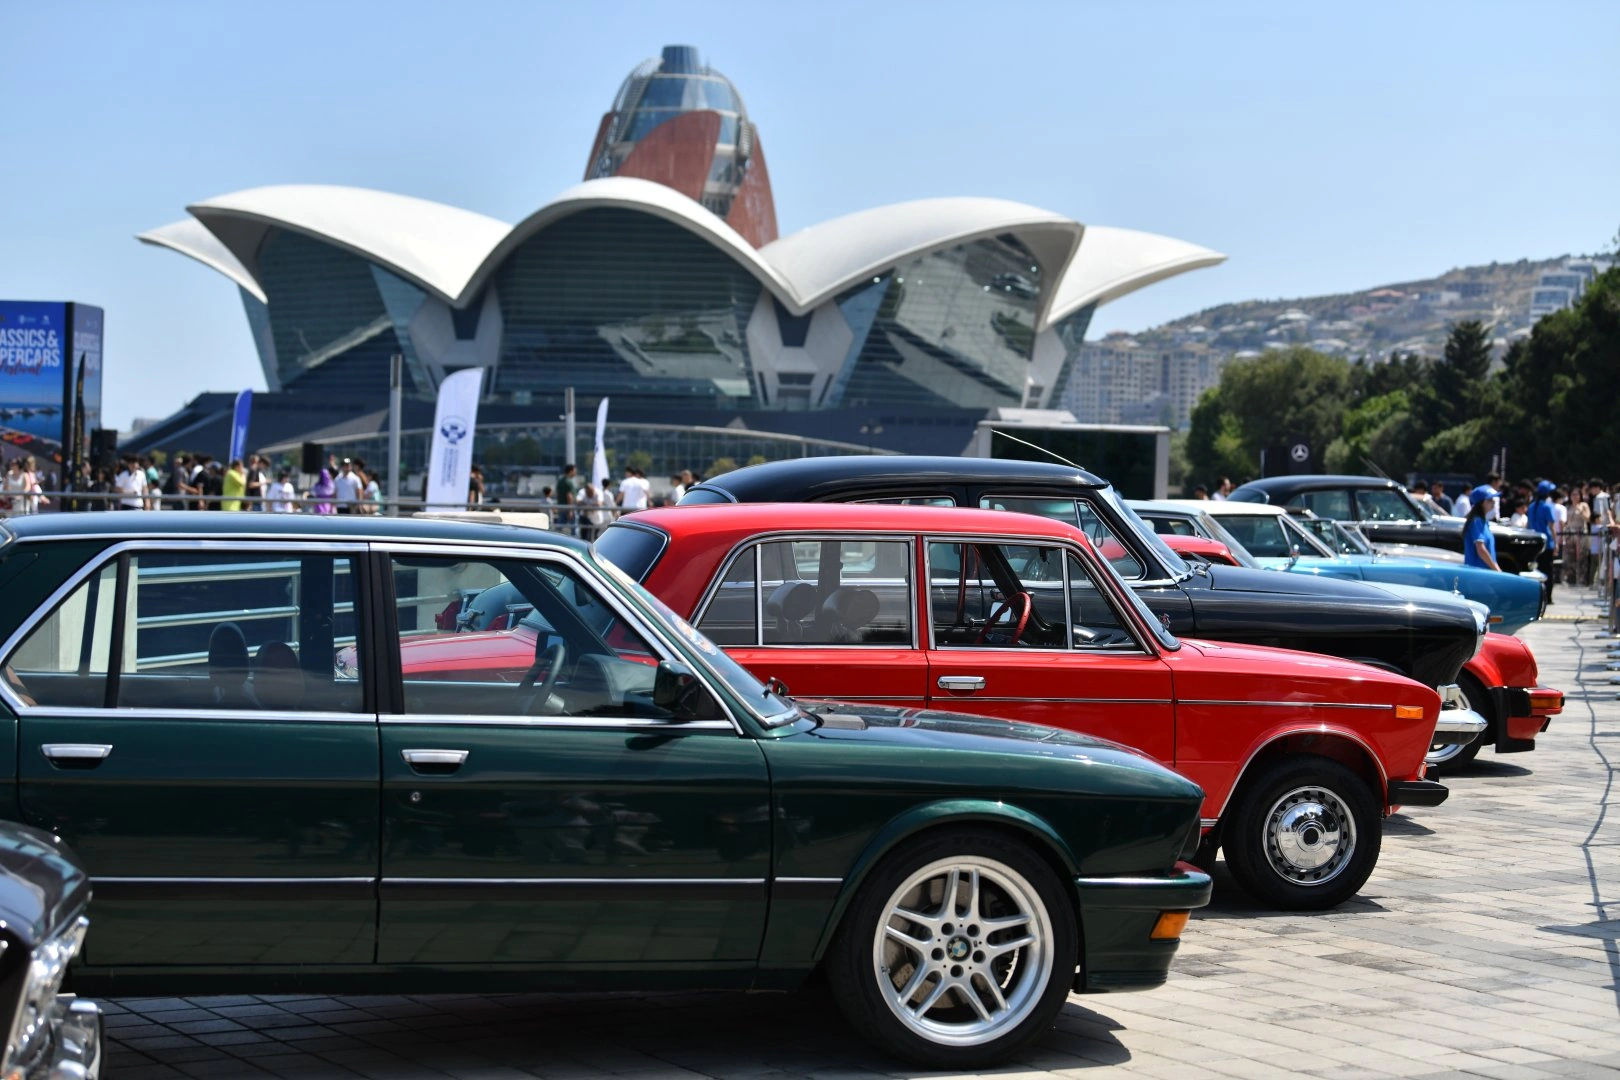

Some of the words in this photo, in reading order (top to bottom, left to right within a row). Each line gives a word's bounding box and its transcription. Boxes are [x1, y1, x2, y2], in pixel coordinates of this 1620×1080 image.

[0, 328, 46, 347] ASSICS
[47, 329, 58, 348] &
[0, 348, 60, 367] PERCARS
